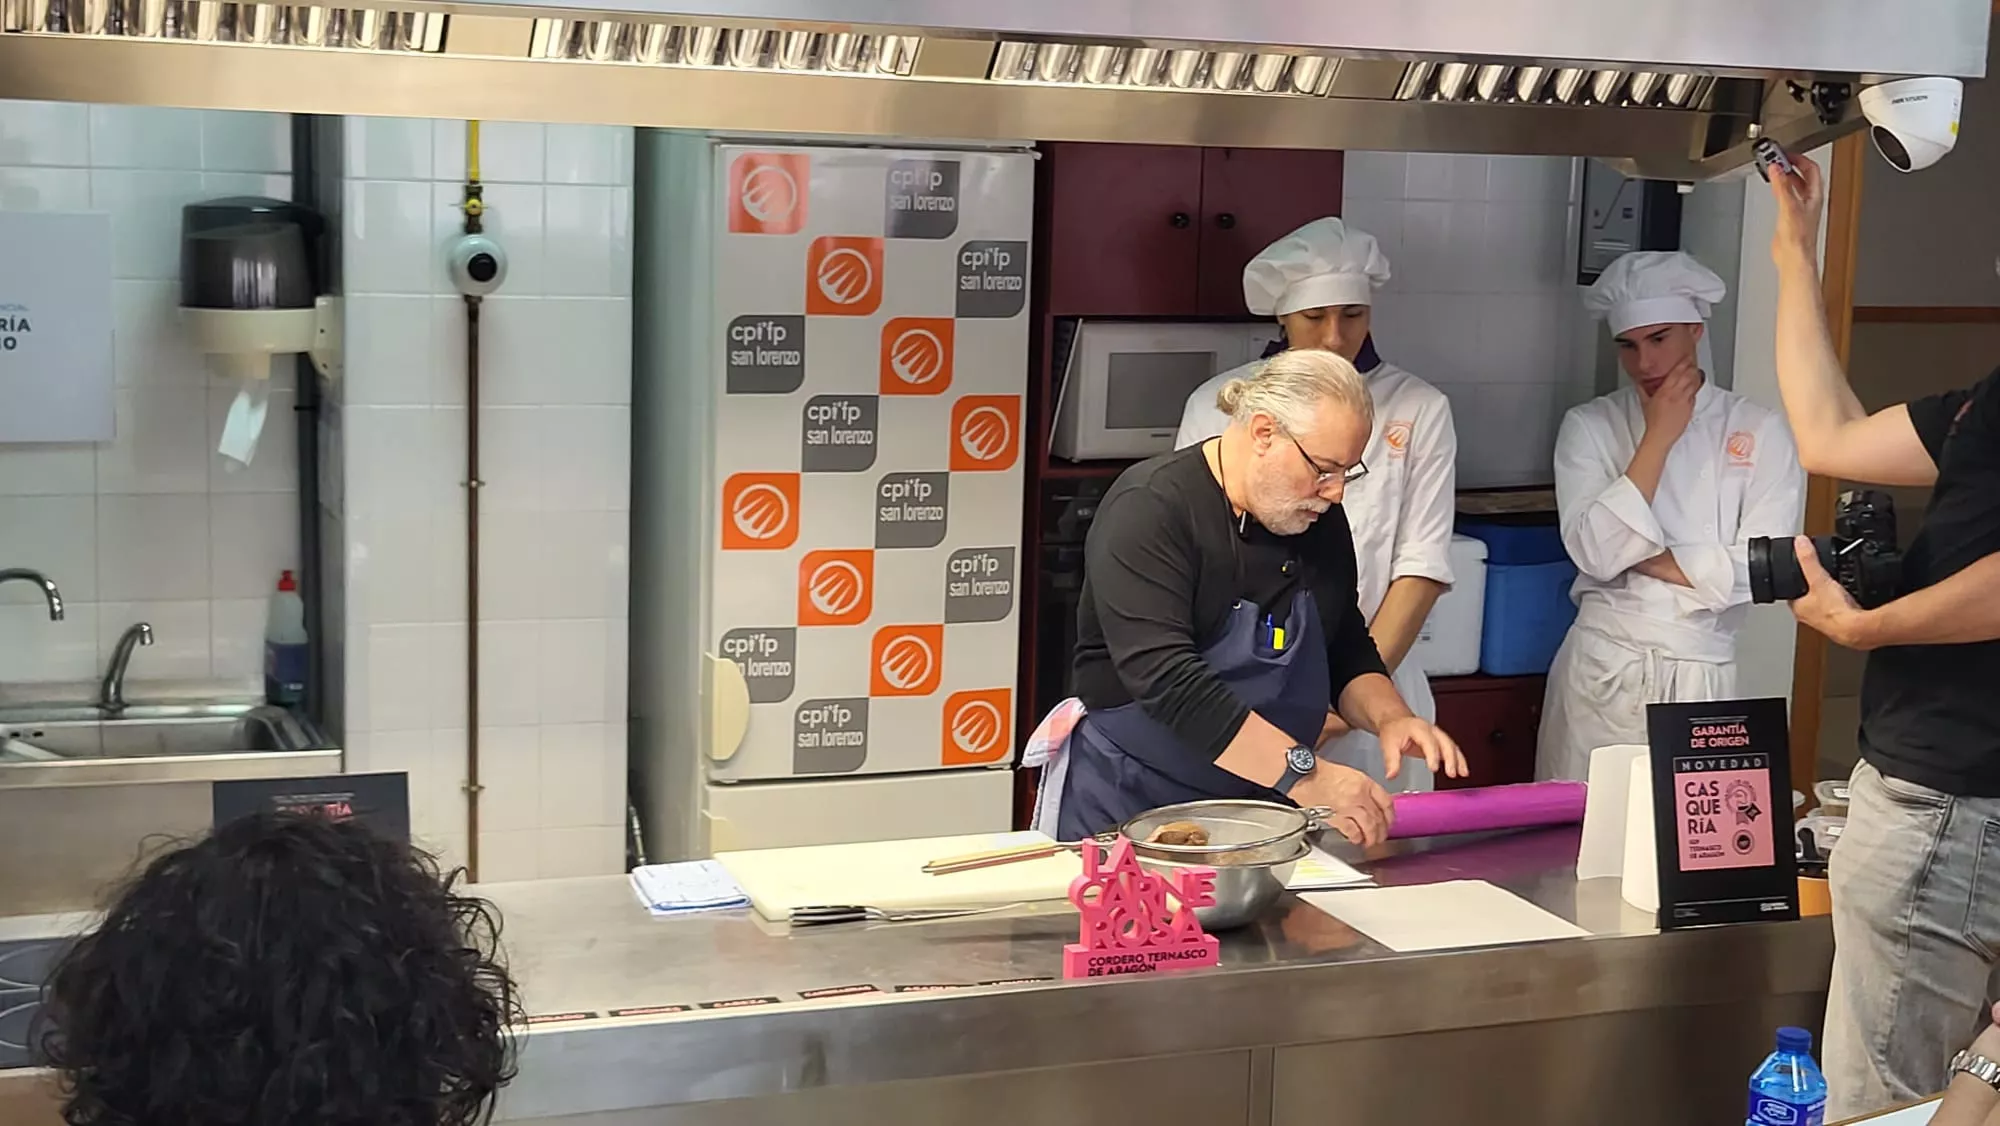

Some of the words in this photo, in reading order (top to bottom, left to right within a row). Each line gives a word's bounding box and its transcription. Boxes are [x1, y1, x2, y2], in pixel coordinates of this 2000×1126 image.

[890, 194, 911, 210] san
[914, 193, 955, 211] lorenzo
[960, 275, 981, 290] san
[983, 271, 1022, 291] lorenzo
[731, 351, 754, 366] san
[756, 346, 801, 366] lorenzo
[807, 429, 828, 445] san
[830, 424, 873, 444] lorenzo
[880, 507, 900, 521] san
[903, 501, 944, 521] lorenzo
[950, 581, 969, 596] san
[970, 576, 1010, 596] lorenzo
[748, 658, 791, 676] lorenzo
[798, 732, 820, 747] san
[822, 726, 863, 746] lorenzo
[1692, 722, 1748, 736] GARANTÍA
[1691, 738, 1706, 748] DE
[1708, 736, 1749, 747] ORIGEN
[1682, 758, 1762, 771] NOVEDAD
[1685, 780, 1719, 798] CAS
[1686, 799, 1720, 816] QUE
[1688, 817, 1717, 835] RÍA
[1082, 832, 1144, 881] LA
[1069, 866, 1216, 917] CARNE
[1080, 905, 1205, 950] ROSA
[1088, 954, 1144, 967] CORDERO
[1147, 949, 1207, 962] TERNASCO
[1088, 967, 1104, 977] DE
[1107, 963, 1156, 976] ARAGÓN
